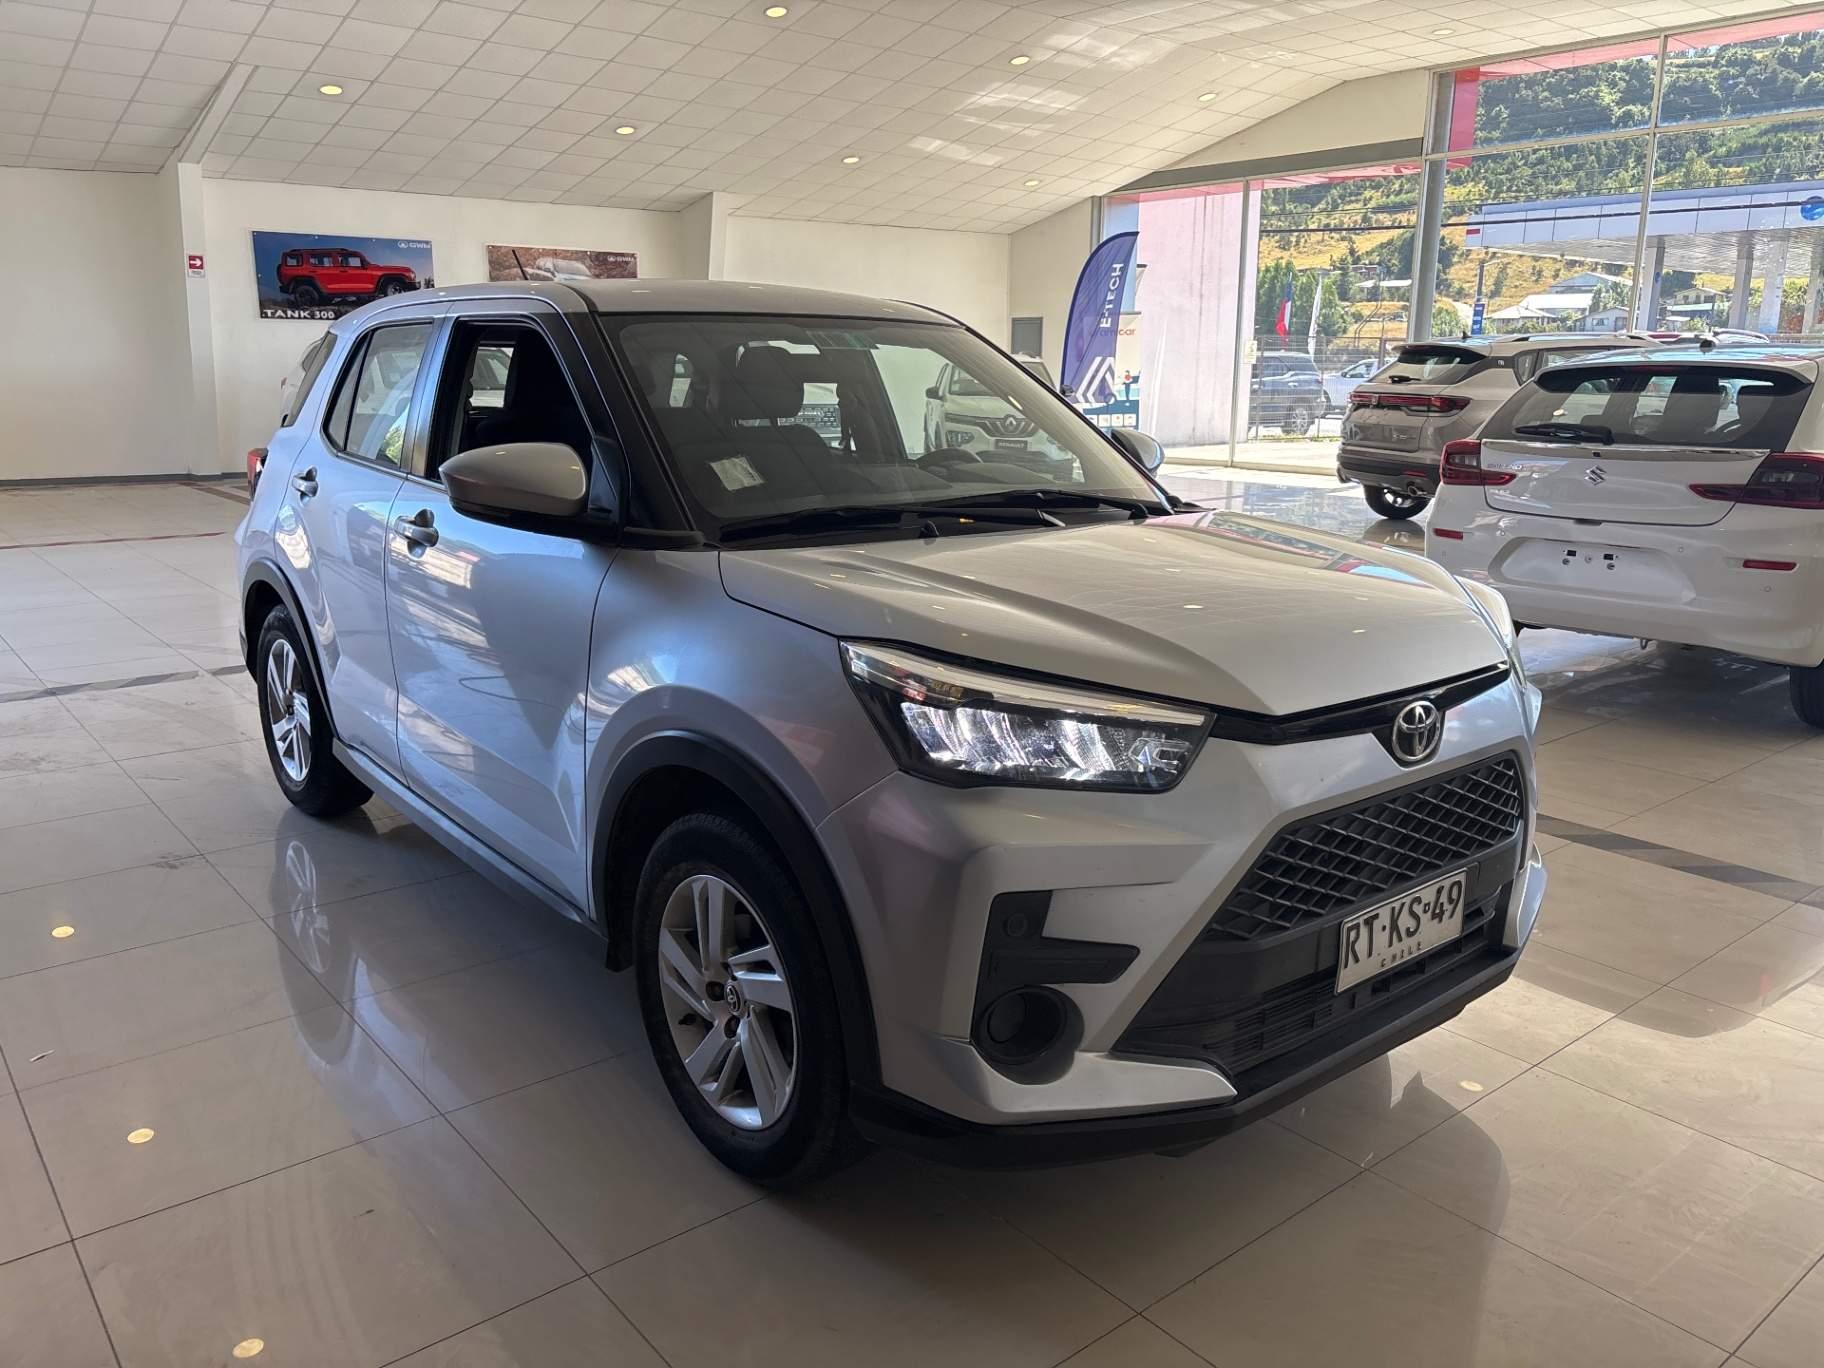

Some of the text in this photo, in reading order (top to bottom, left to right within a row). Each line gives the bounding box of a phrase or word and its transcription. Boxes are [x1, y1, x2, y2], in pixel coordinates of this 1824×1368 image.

[1100, 263, 1124, 328] E-TECH
[263, 309, 335, 319] TANK 300
[1380, 941, 1422, 968] CHILE
